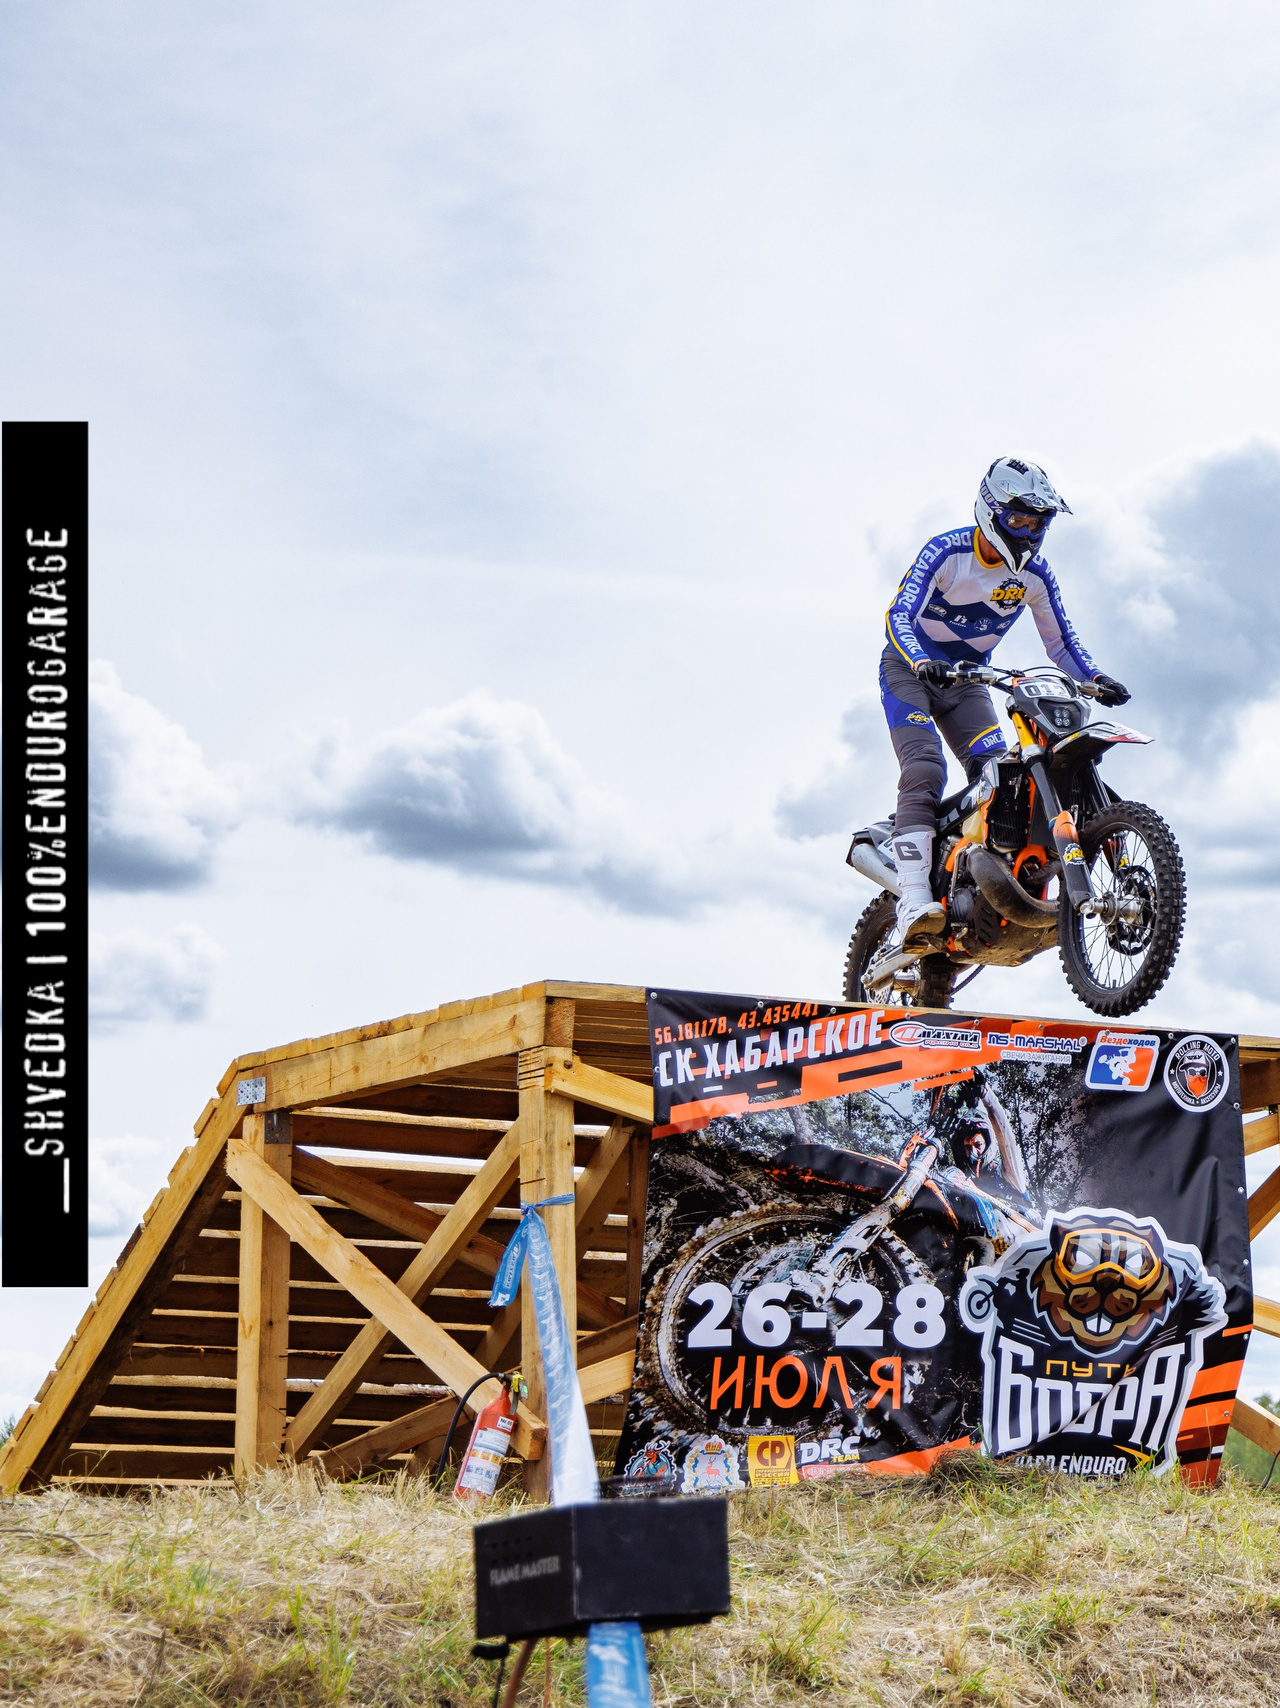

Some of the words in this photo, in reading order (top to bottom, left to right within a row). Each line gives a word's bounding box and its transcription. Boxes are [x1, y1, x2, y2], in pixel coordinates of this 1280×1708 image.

[905, 543, 944, 589] TEAM
[654, 1016, 733, 1046] 56.181178,
[737, 1002, 819, 1031] 43.435441
[658, 1047, 696, 1087] СК
[703, 1009, 886, 1080] ХАБАРСКОЕ
[1100, 1035, 1156, 1047] Вездеходов
[1175, 1041, 1201, 1060] ROLLING
[1203, 1043, 1221, 1061] MOTO
[1001, 1051, 1026, 1060] СВЕЧИ
[1027, 1053, 1071, 1063] ЗАЖИГАНИЯ
[687, 1282, 946, 1348] 26-28
[1045, 1359, 1137, 1379] ПУТЬ
[710, 1355, 902, 1410] ИЮЛЯ
[801, 1436, 861, 1464] DRC
[831, 1453, 861, 1464] TEAM
[1059, 1455, 1127, 1475] ENDURO
[521, 1555, 560, 1579] MASTER
